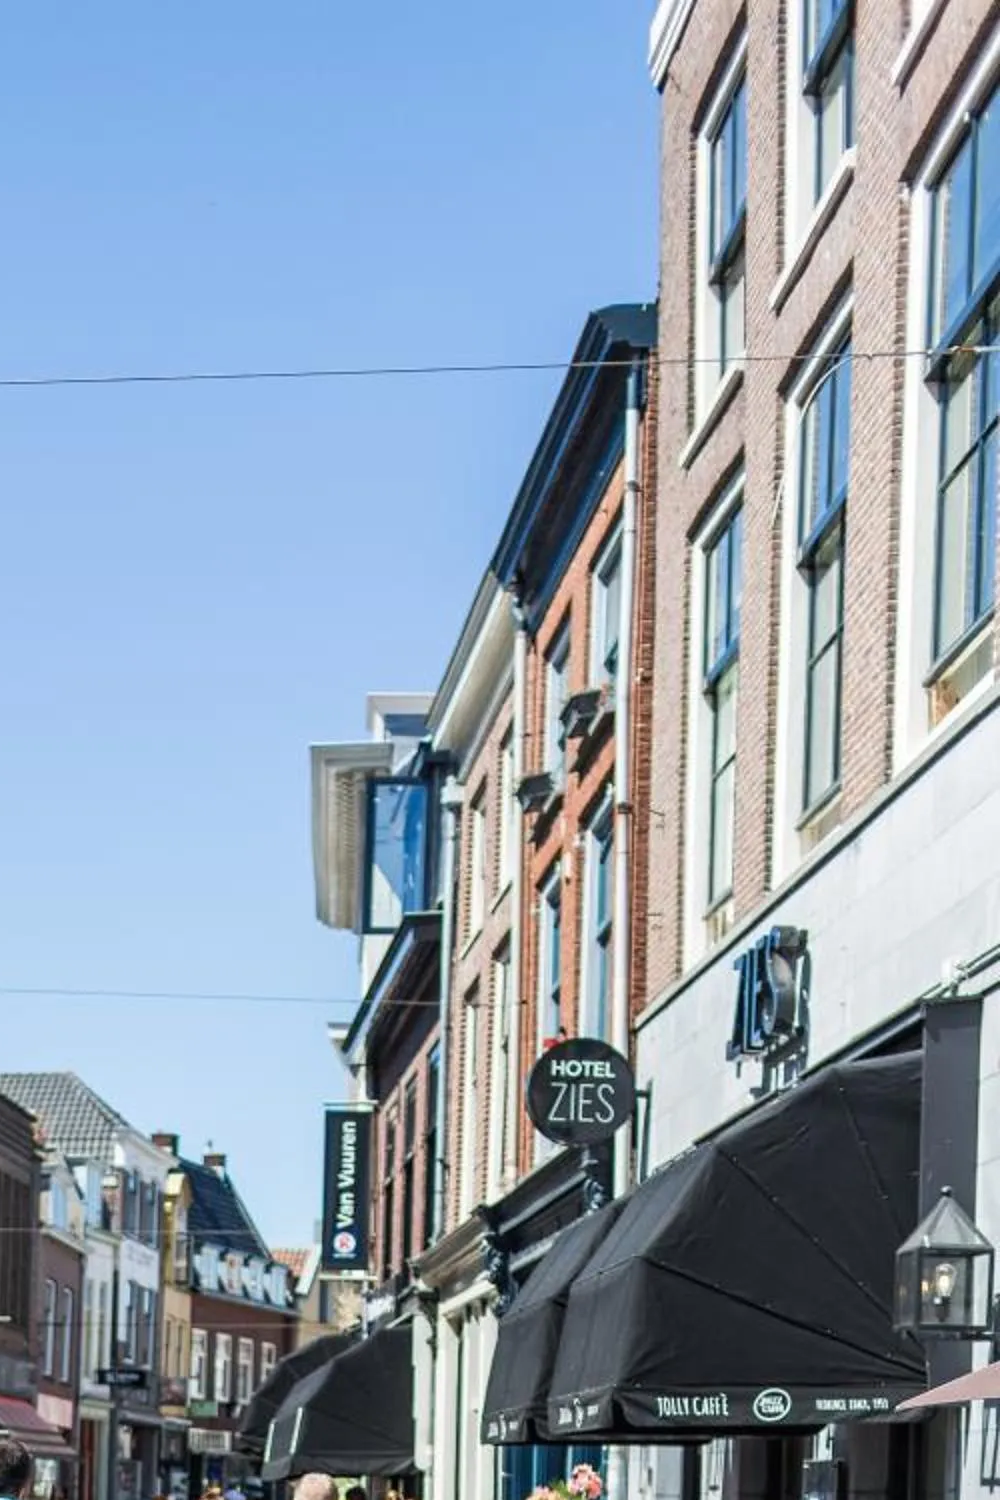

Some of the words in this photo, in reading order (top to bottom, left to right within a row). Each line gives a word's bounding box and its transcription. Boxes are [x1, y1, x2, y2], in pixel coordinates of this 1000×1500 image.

[551, 1060, 616, 1078] HOTEL
[548, 1082, 615, 1124] ZIES
[337, 1120, 357, 1188] Vuuren
[336, 1191, 356, 1229] Van
[657, 1396, 690, 1417] JOLLY
[693, 1392, 729, 1417] CAFFÈ
